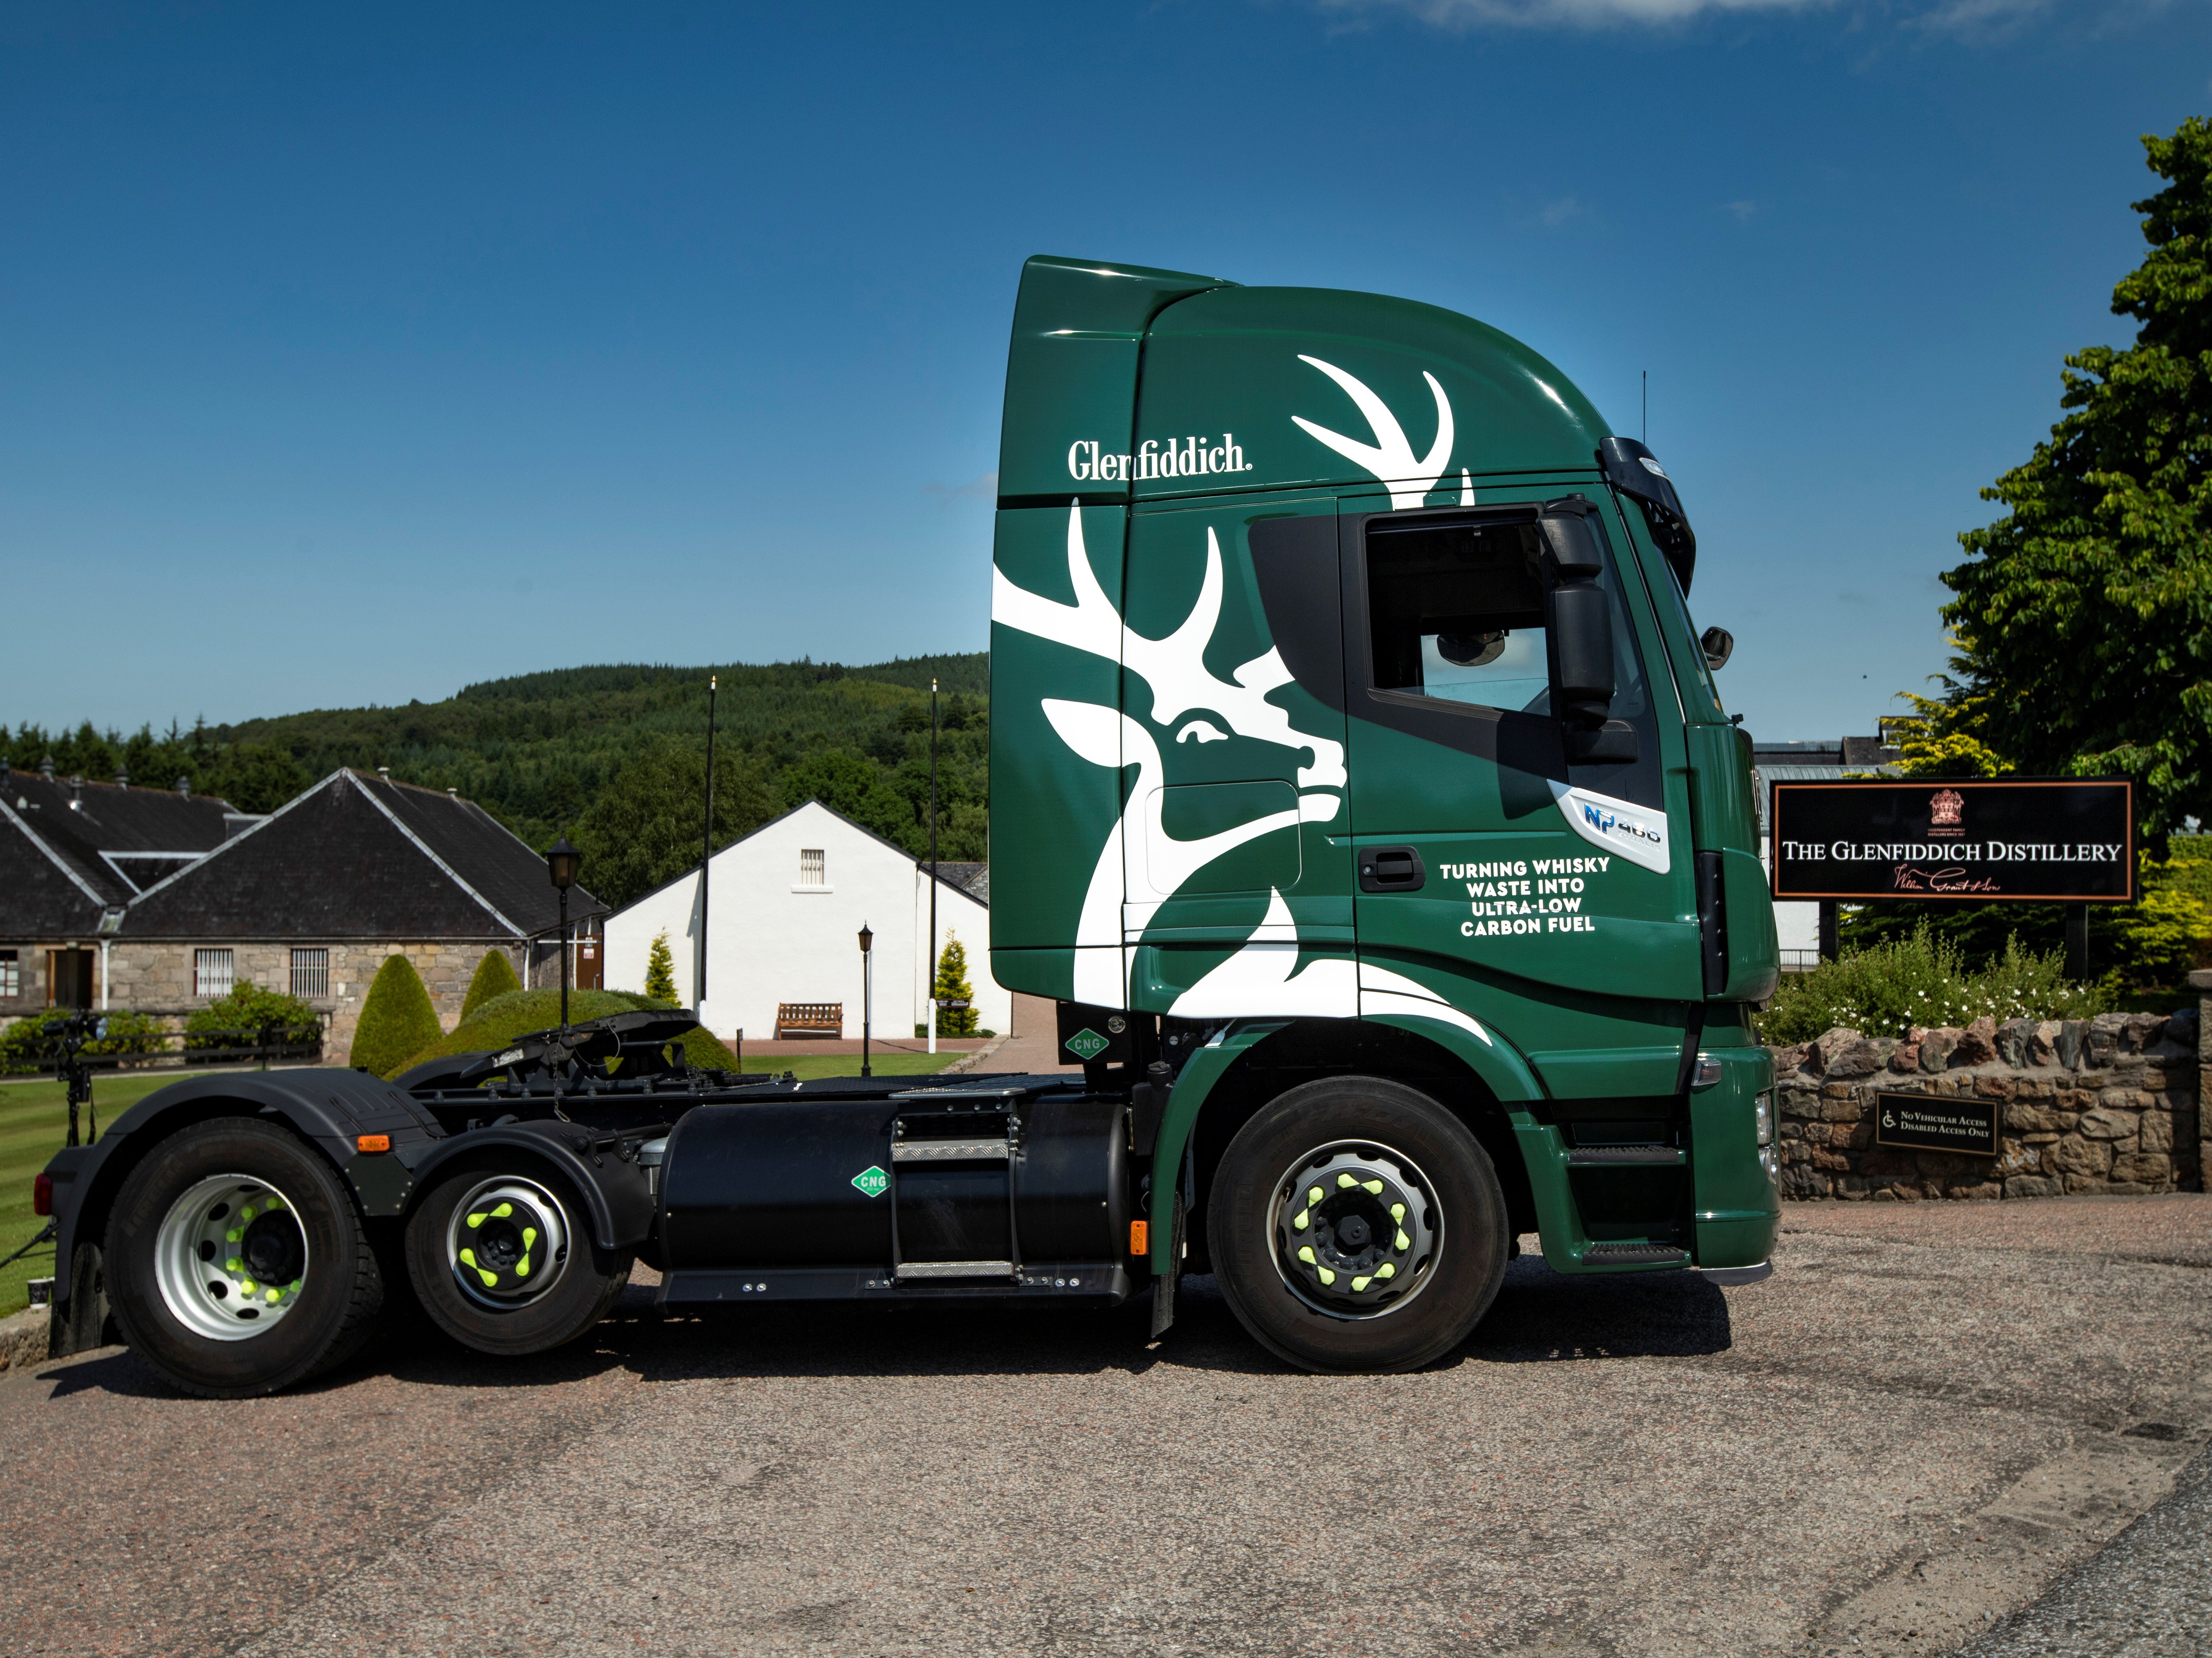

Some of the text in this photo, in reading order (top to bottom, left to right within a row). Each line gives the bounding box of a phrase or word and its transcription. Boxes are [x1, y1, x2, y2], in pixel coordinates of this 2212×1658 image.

[1618, 818, 1661, 843] 460
[1617, 830, 1661, 852] STRALIS
[1783, 841, 2122, 861] THE GLENFIDDICH DISTILLERY
[1439, 857, 1610, 879] TURNING WHISKY
[1466, 878, 1584, 898] WASTE INTO
[1930, 867, 1969, 892] Grant
[1982, 877, 2001, 892] Sons
[1472, 897, 1582, 916] ULTRA-LOW
[1461, 916, 1595, 937] CARBON FUEL
[1074, 1038, 1100, 1050] CNG
[1901, 1111, 1987, 1127] NO VEHICULAR ACCESS
[1900, 1121, 1990, 1138] DISABLED ACCESS ONLY
[861, 1176, 886, 1187] CNG
